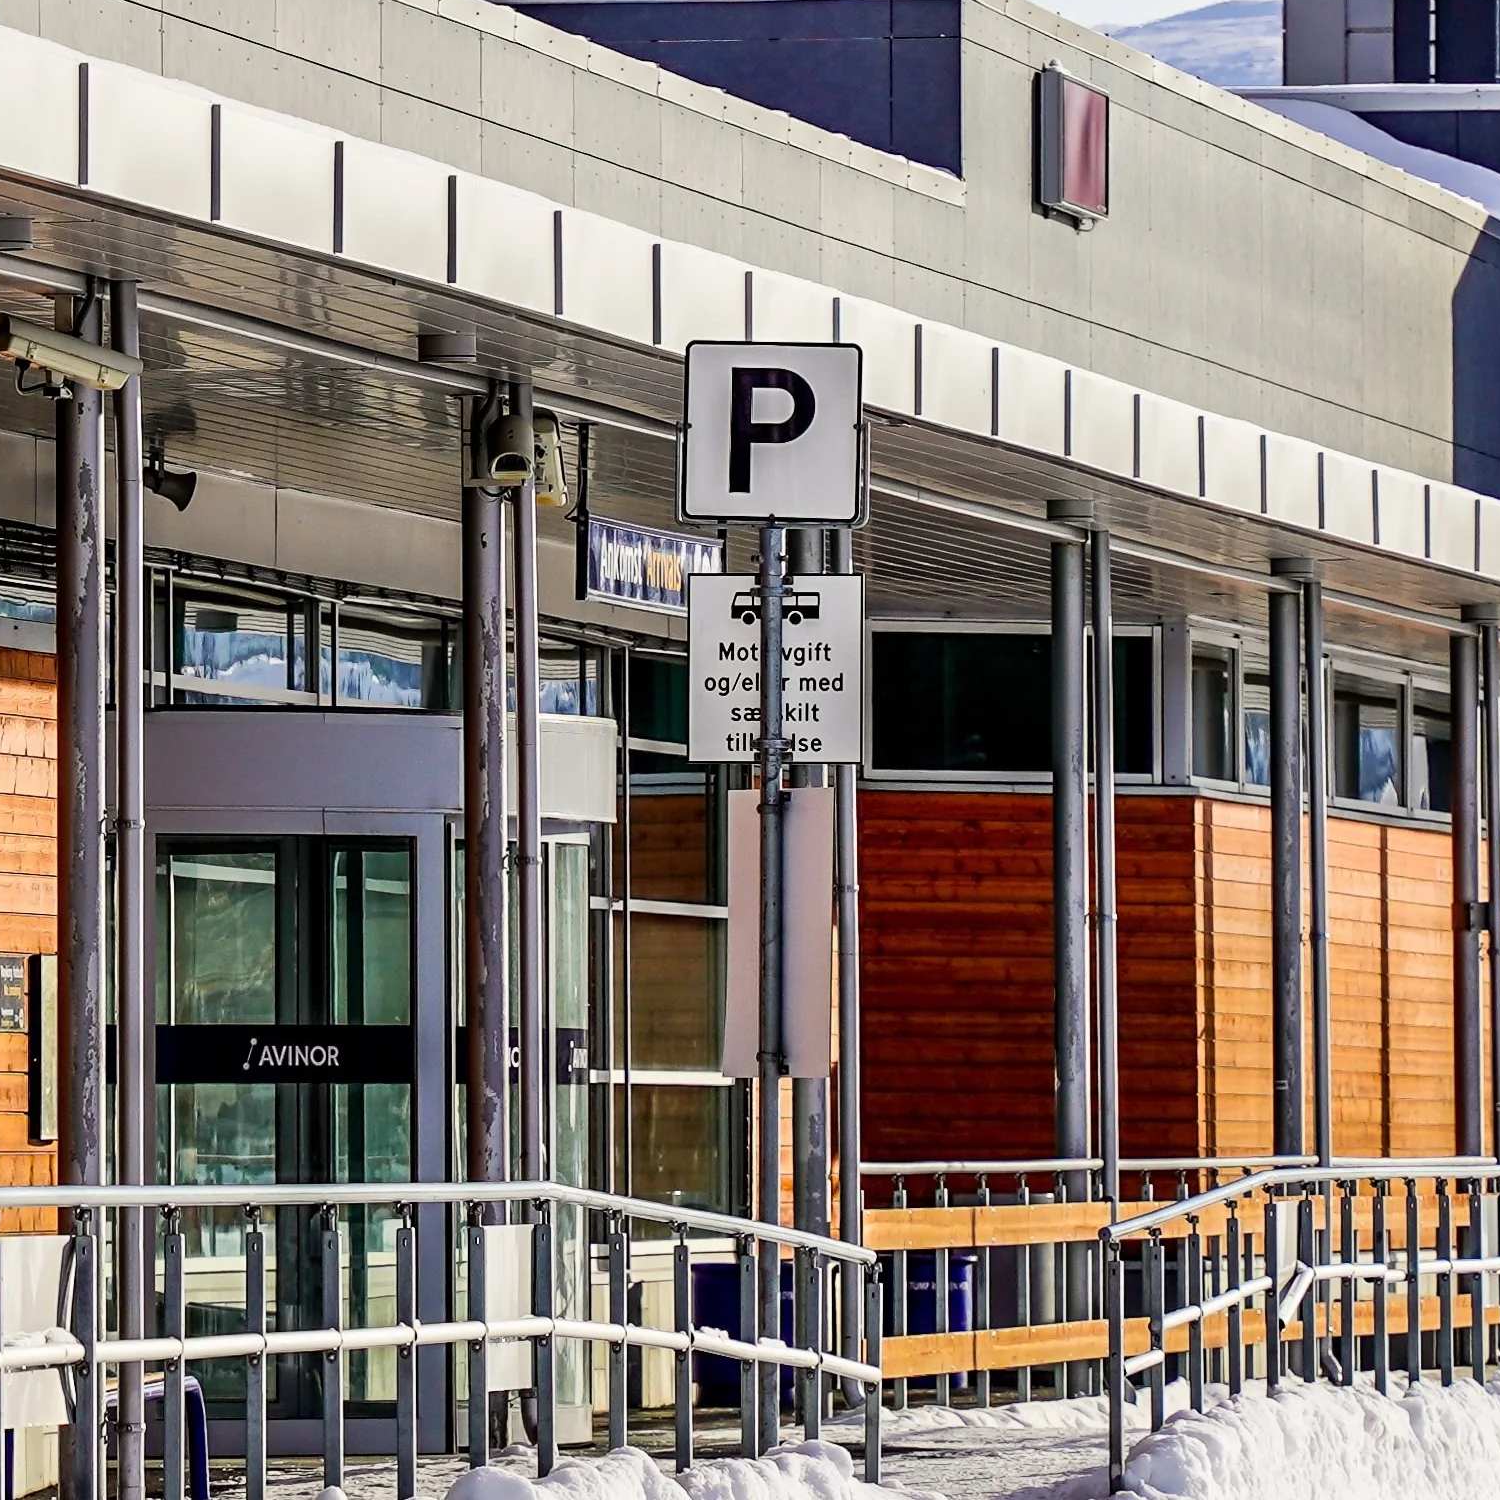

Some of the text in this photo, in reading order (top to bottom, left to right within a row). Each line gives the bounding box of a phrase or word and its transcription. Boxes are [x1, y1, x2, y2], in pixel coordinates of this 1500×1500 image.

[729, 366, 817, 494] P
[600, 529, 643, 586] Ankomst
[718, 642, 832, 667] Mot vgift
[704, 672, 844, 696] og/elr med
[730, 702, 820, 722] sækilt
[725, 732, 823, 753] tilllse
[258, 1045, 340, 1067] AVINOR
